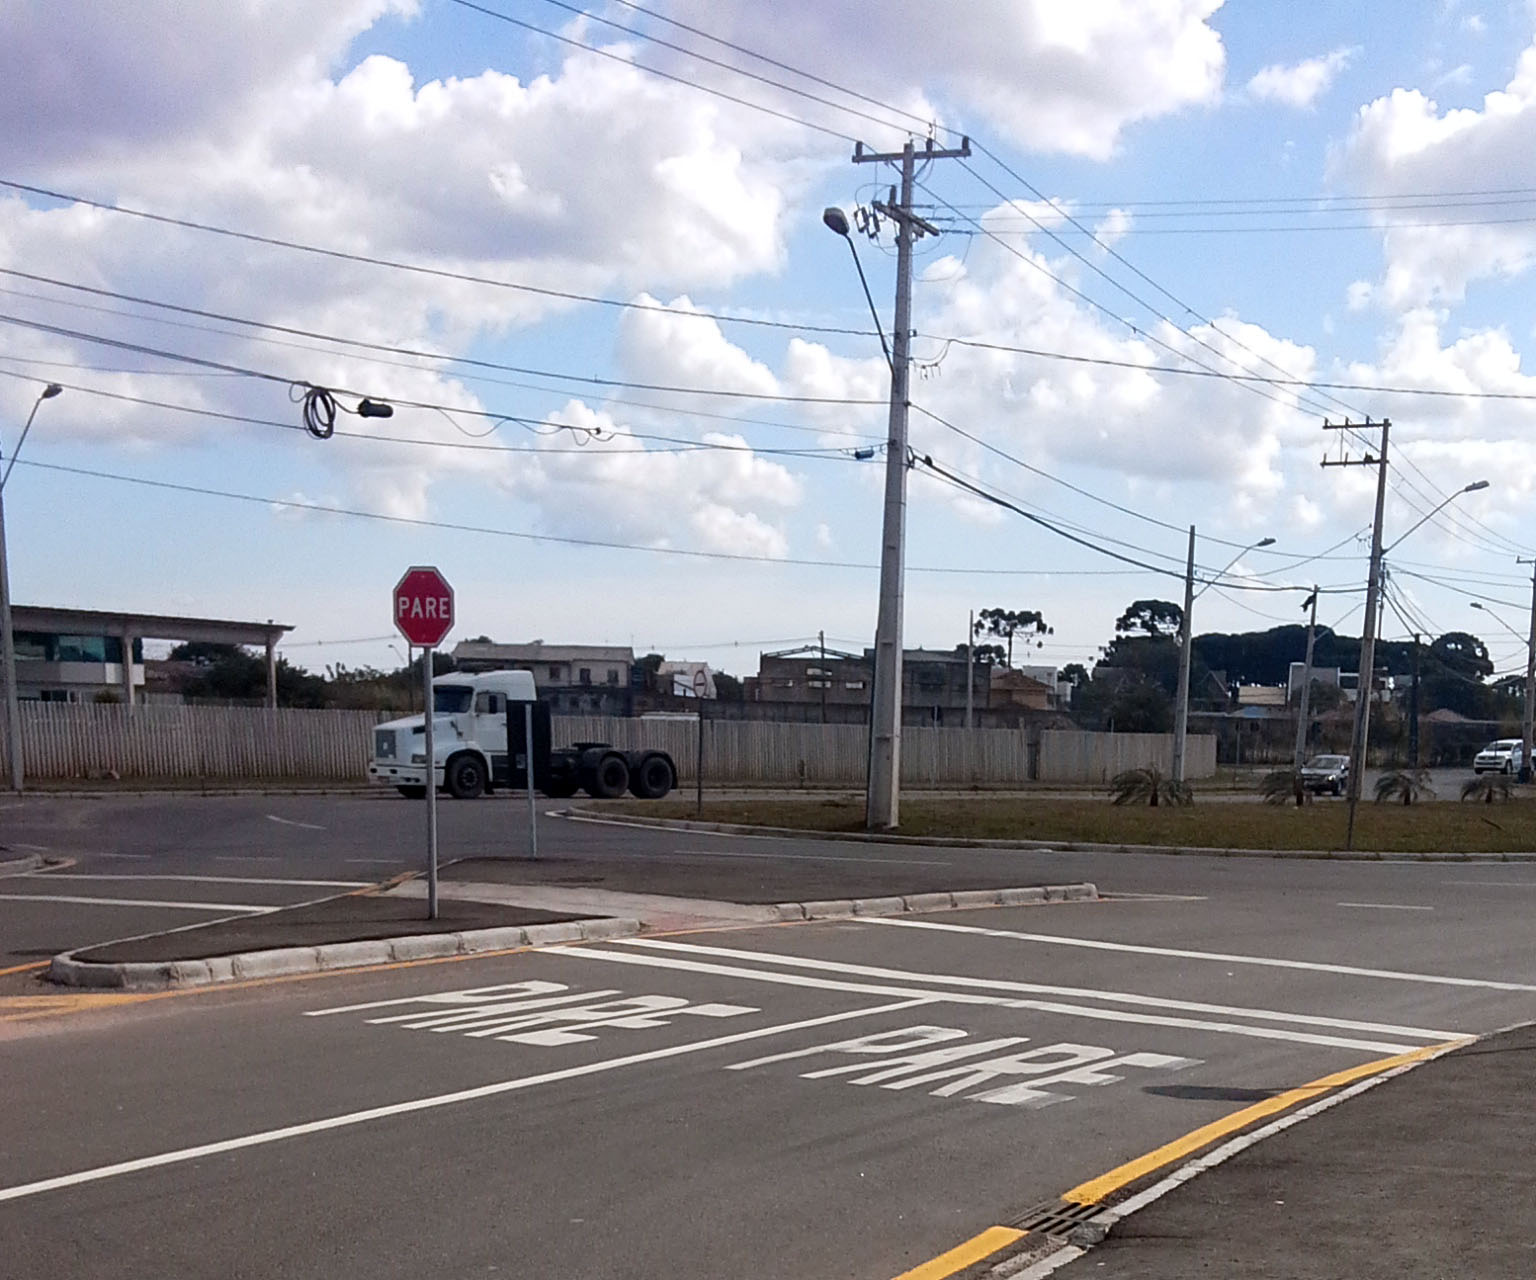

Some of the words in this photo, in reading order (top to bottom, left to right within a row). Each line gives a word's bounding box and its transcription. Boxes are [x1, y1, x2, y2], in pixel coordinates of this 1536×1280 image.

[398, 597, 450, 619] PARE
[303, 980, 761, 1047] PARE
[724, 1025, 1205, 1109] PARE
